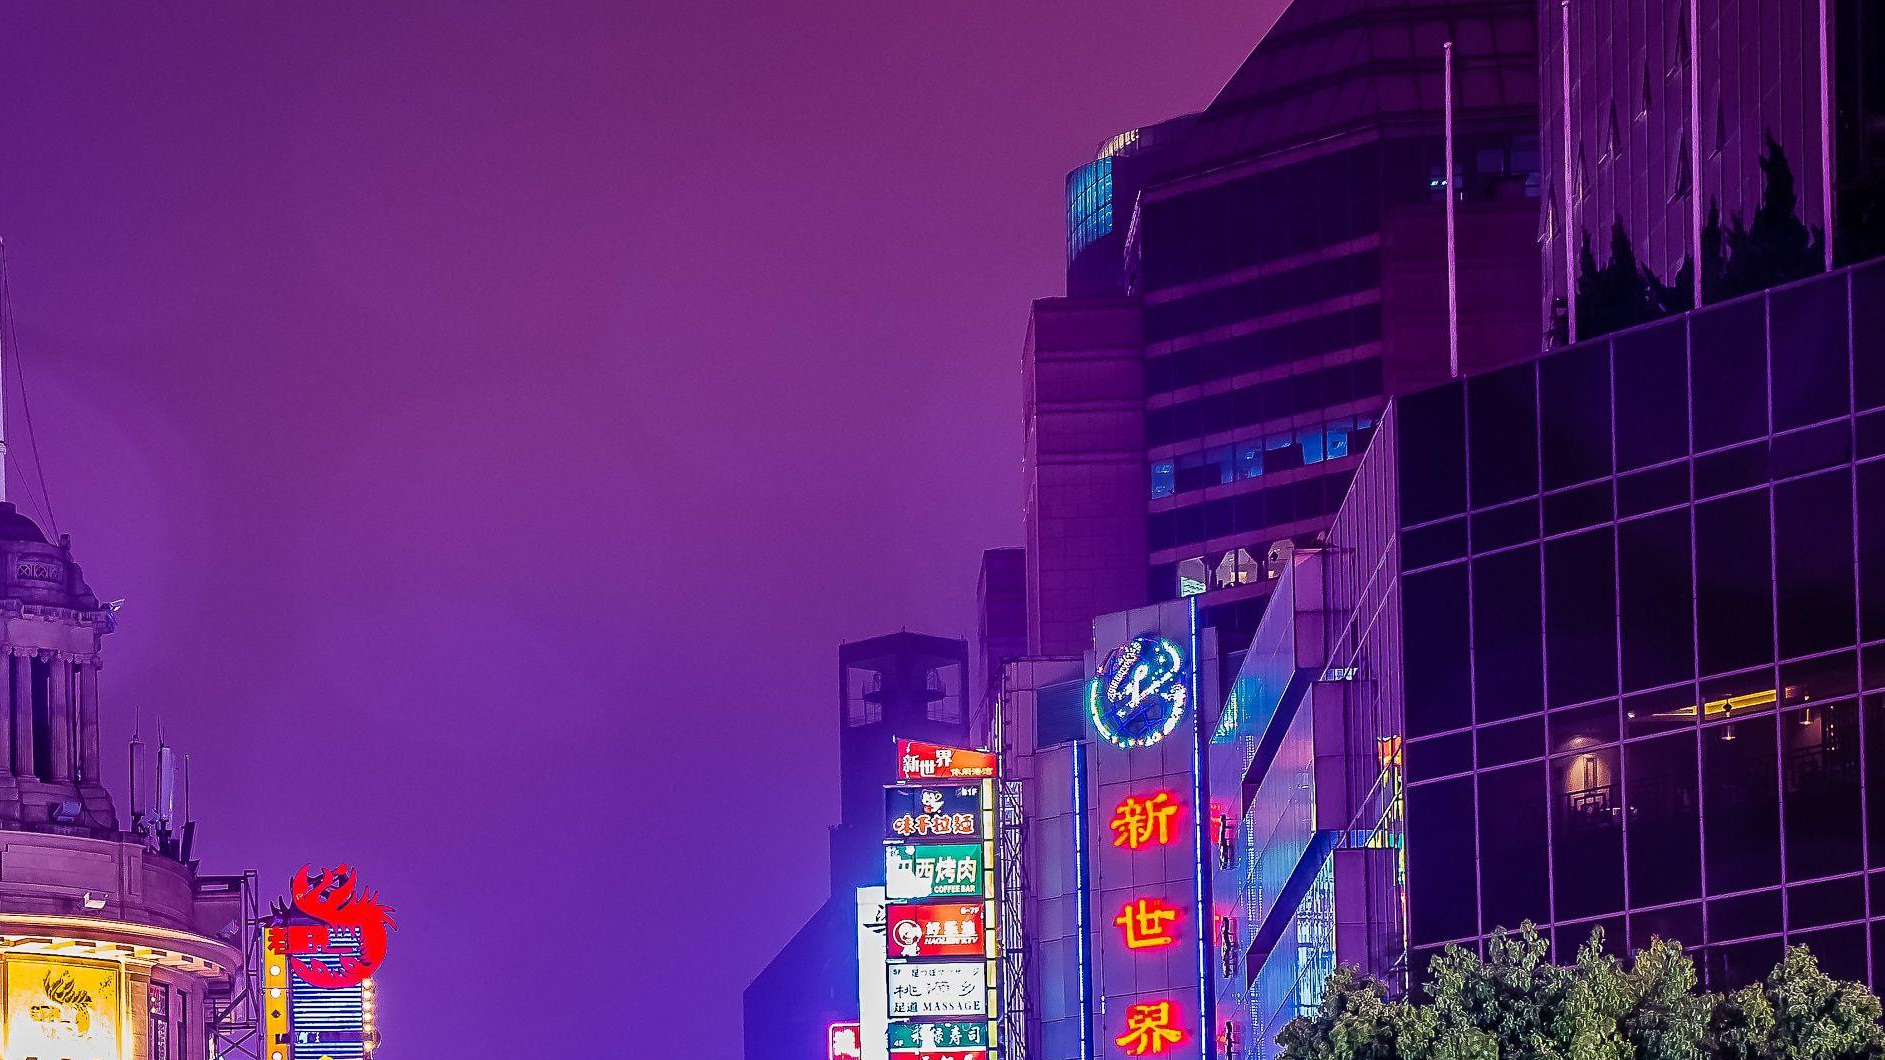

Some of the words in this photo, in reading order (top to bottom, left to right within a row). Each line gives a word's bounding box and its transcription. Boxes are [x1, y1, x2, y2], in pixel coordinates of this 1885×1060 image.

[903, 749, 953, 777] 新世界
[934, 885, 960, 893] COFFEE
[961, 885, 975, 893] BAR
[1110, 794, 1184, 1056] 新世界
[923, 1001, 980, 1012] MASSAGE
